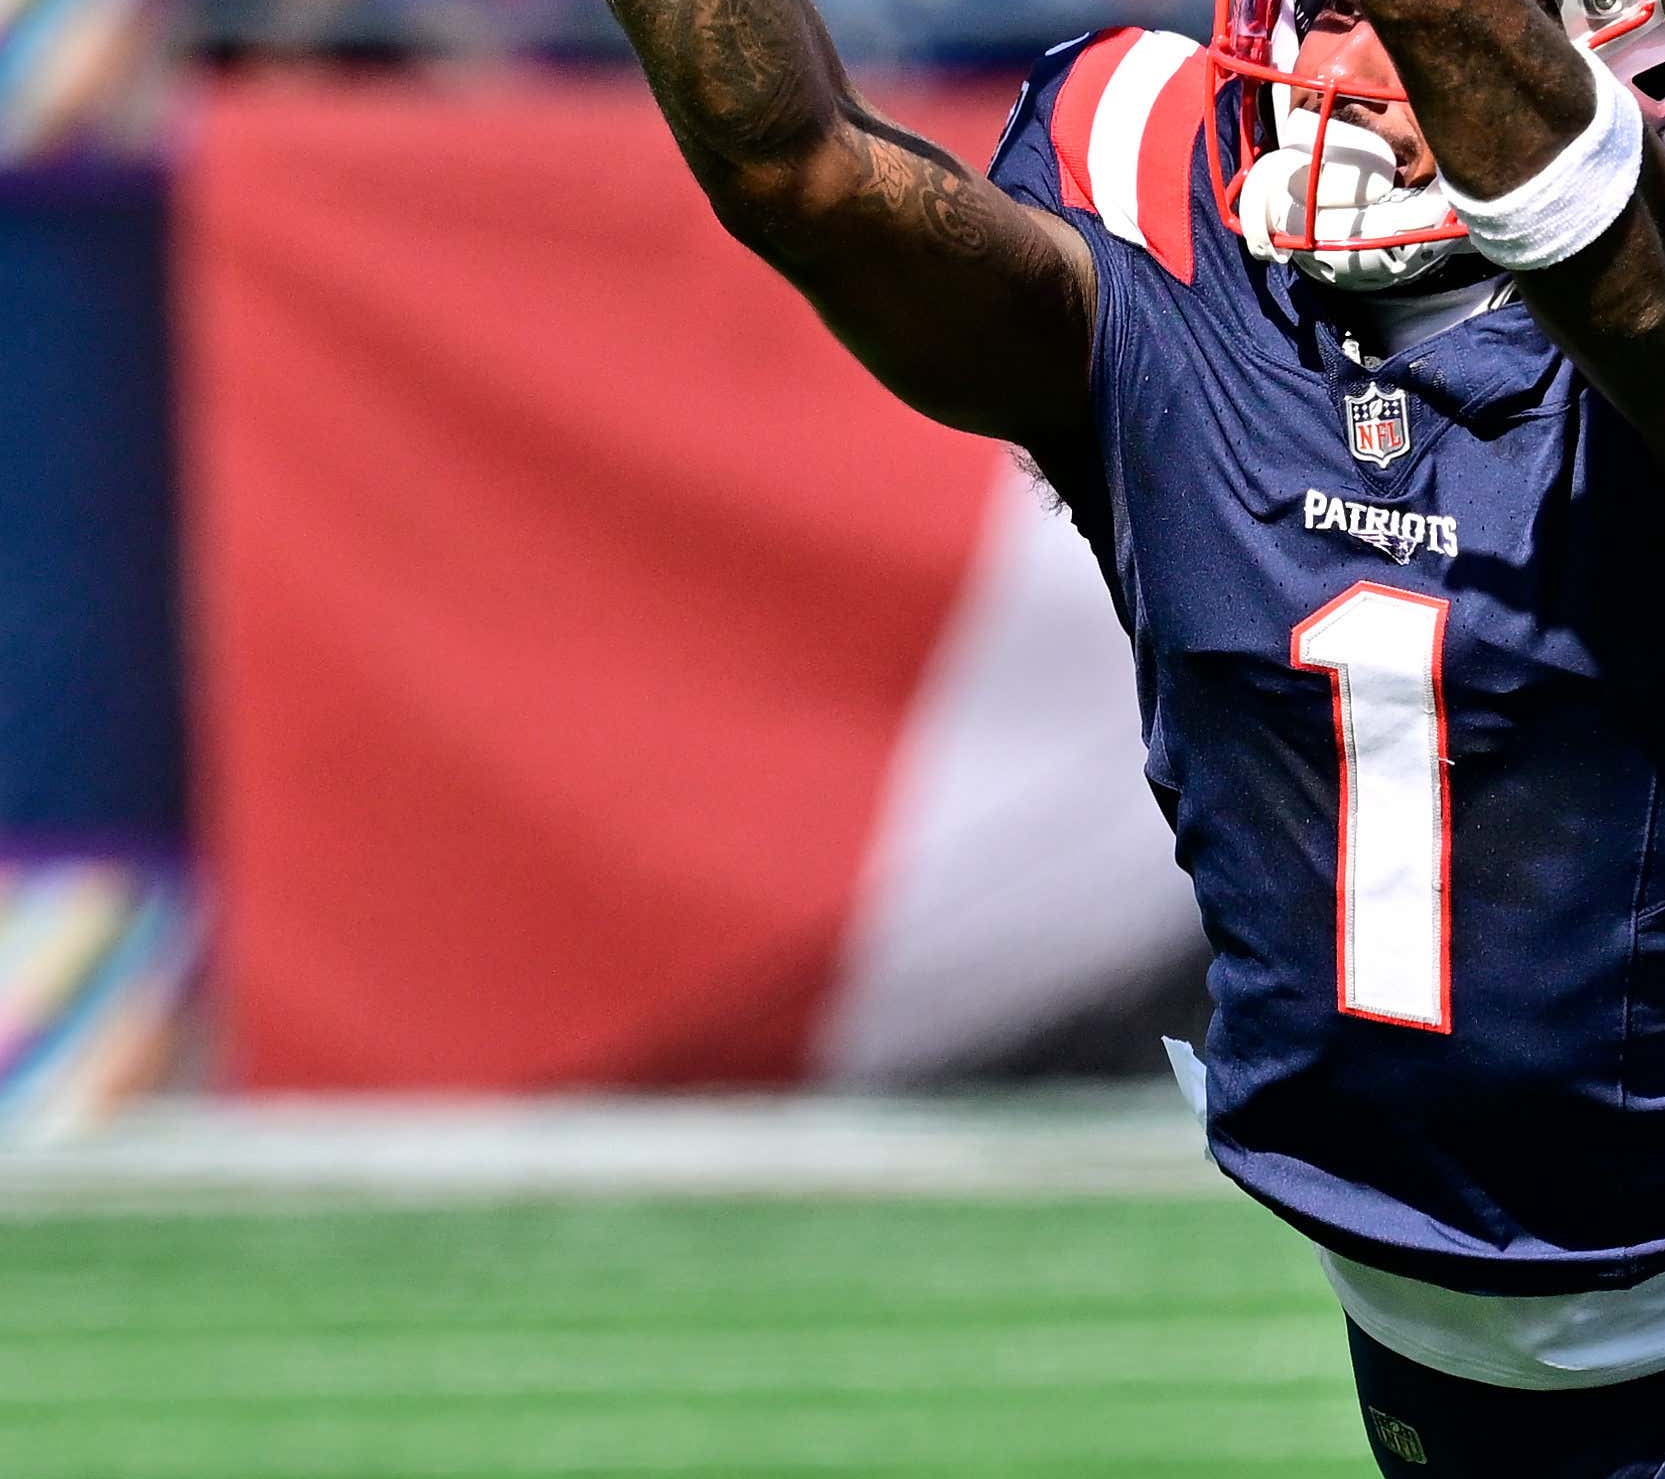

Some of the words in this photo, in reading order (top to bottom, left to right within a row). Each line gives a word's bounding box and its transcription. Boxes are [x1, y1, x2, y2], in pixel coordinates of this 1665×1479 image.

[1357, 420, 1403, 451] NFL
[1304, 488, 1459, 558] PATRIOTS
[1290, 579, 1452, 1035] 1
